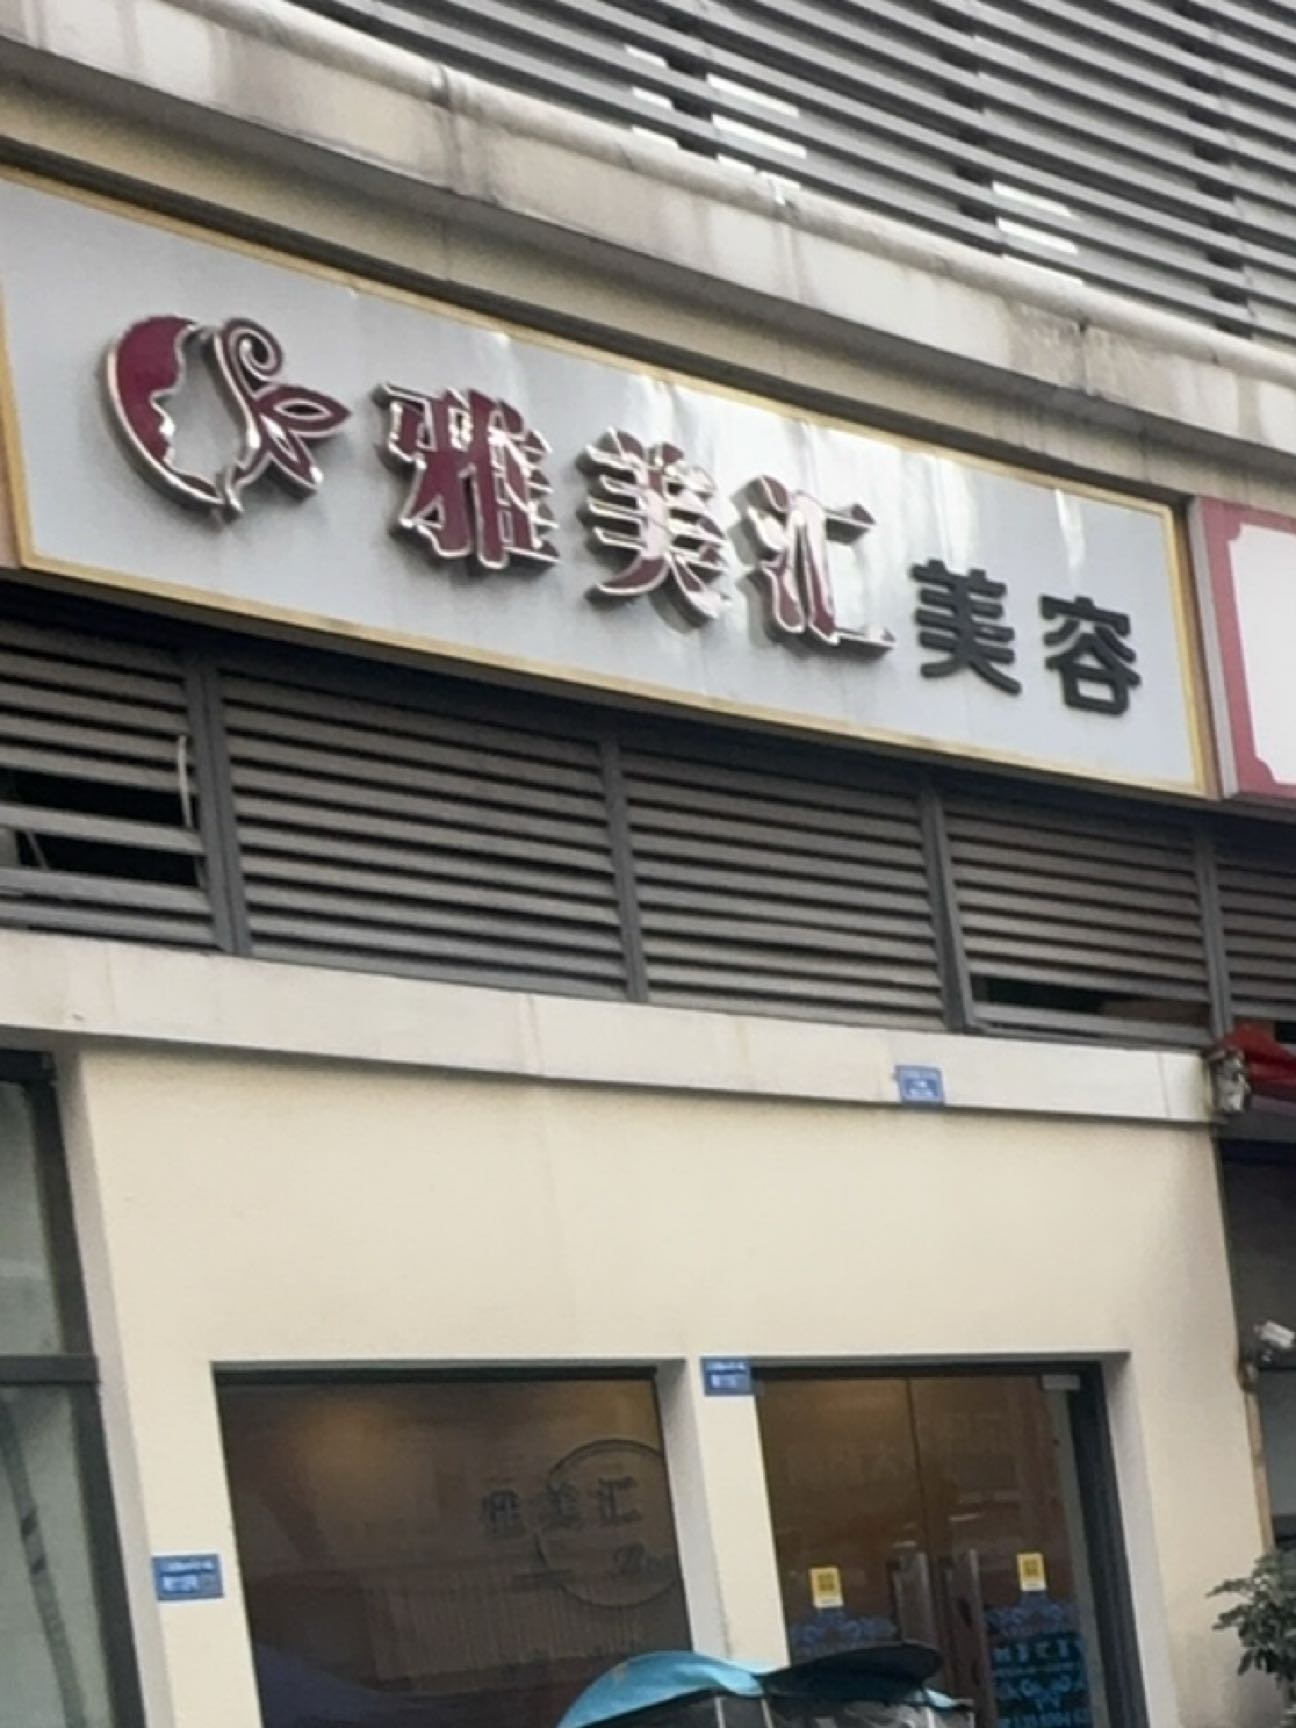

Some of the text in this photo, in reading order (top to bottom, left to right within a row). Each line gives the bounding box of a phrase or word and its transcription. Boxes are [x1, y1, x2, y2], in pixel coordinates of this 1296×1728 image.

[376, 382, 1142, 717] 雅美汇 美容
